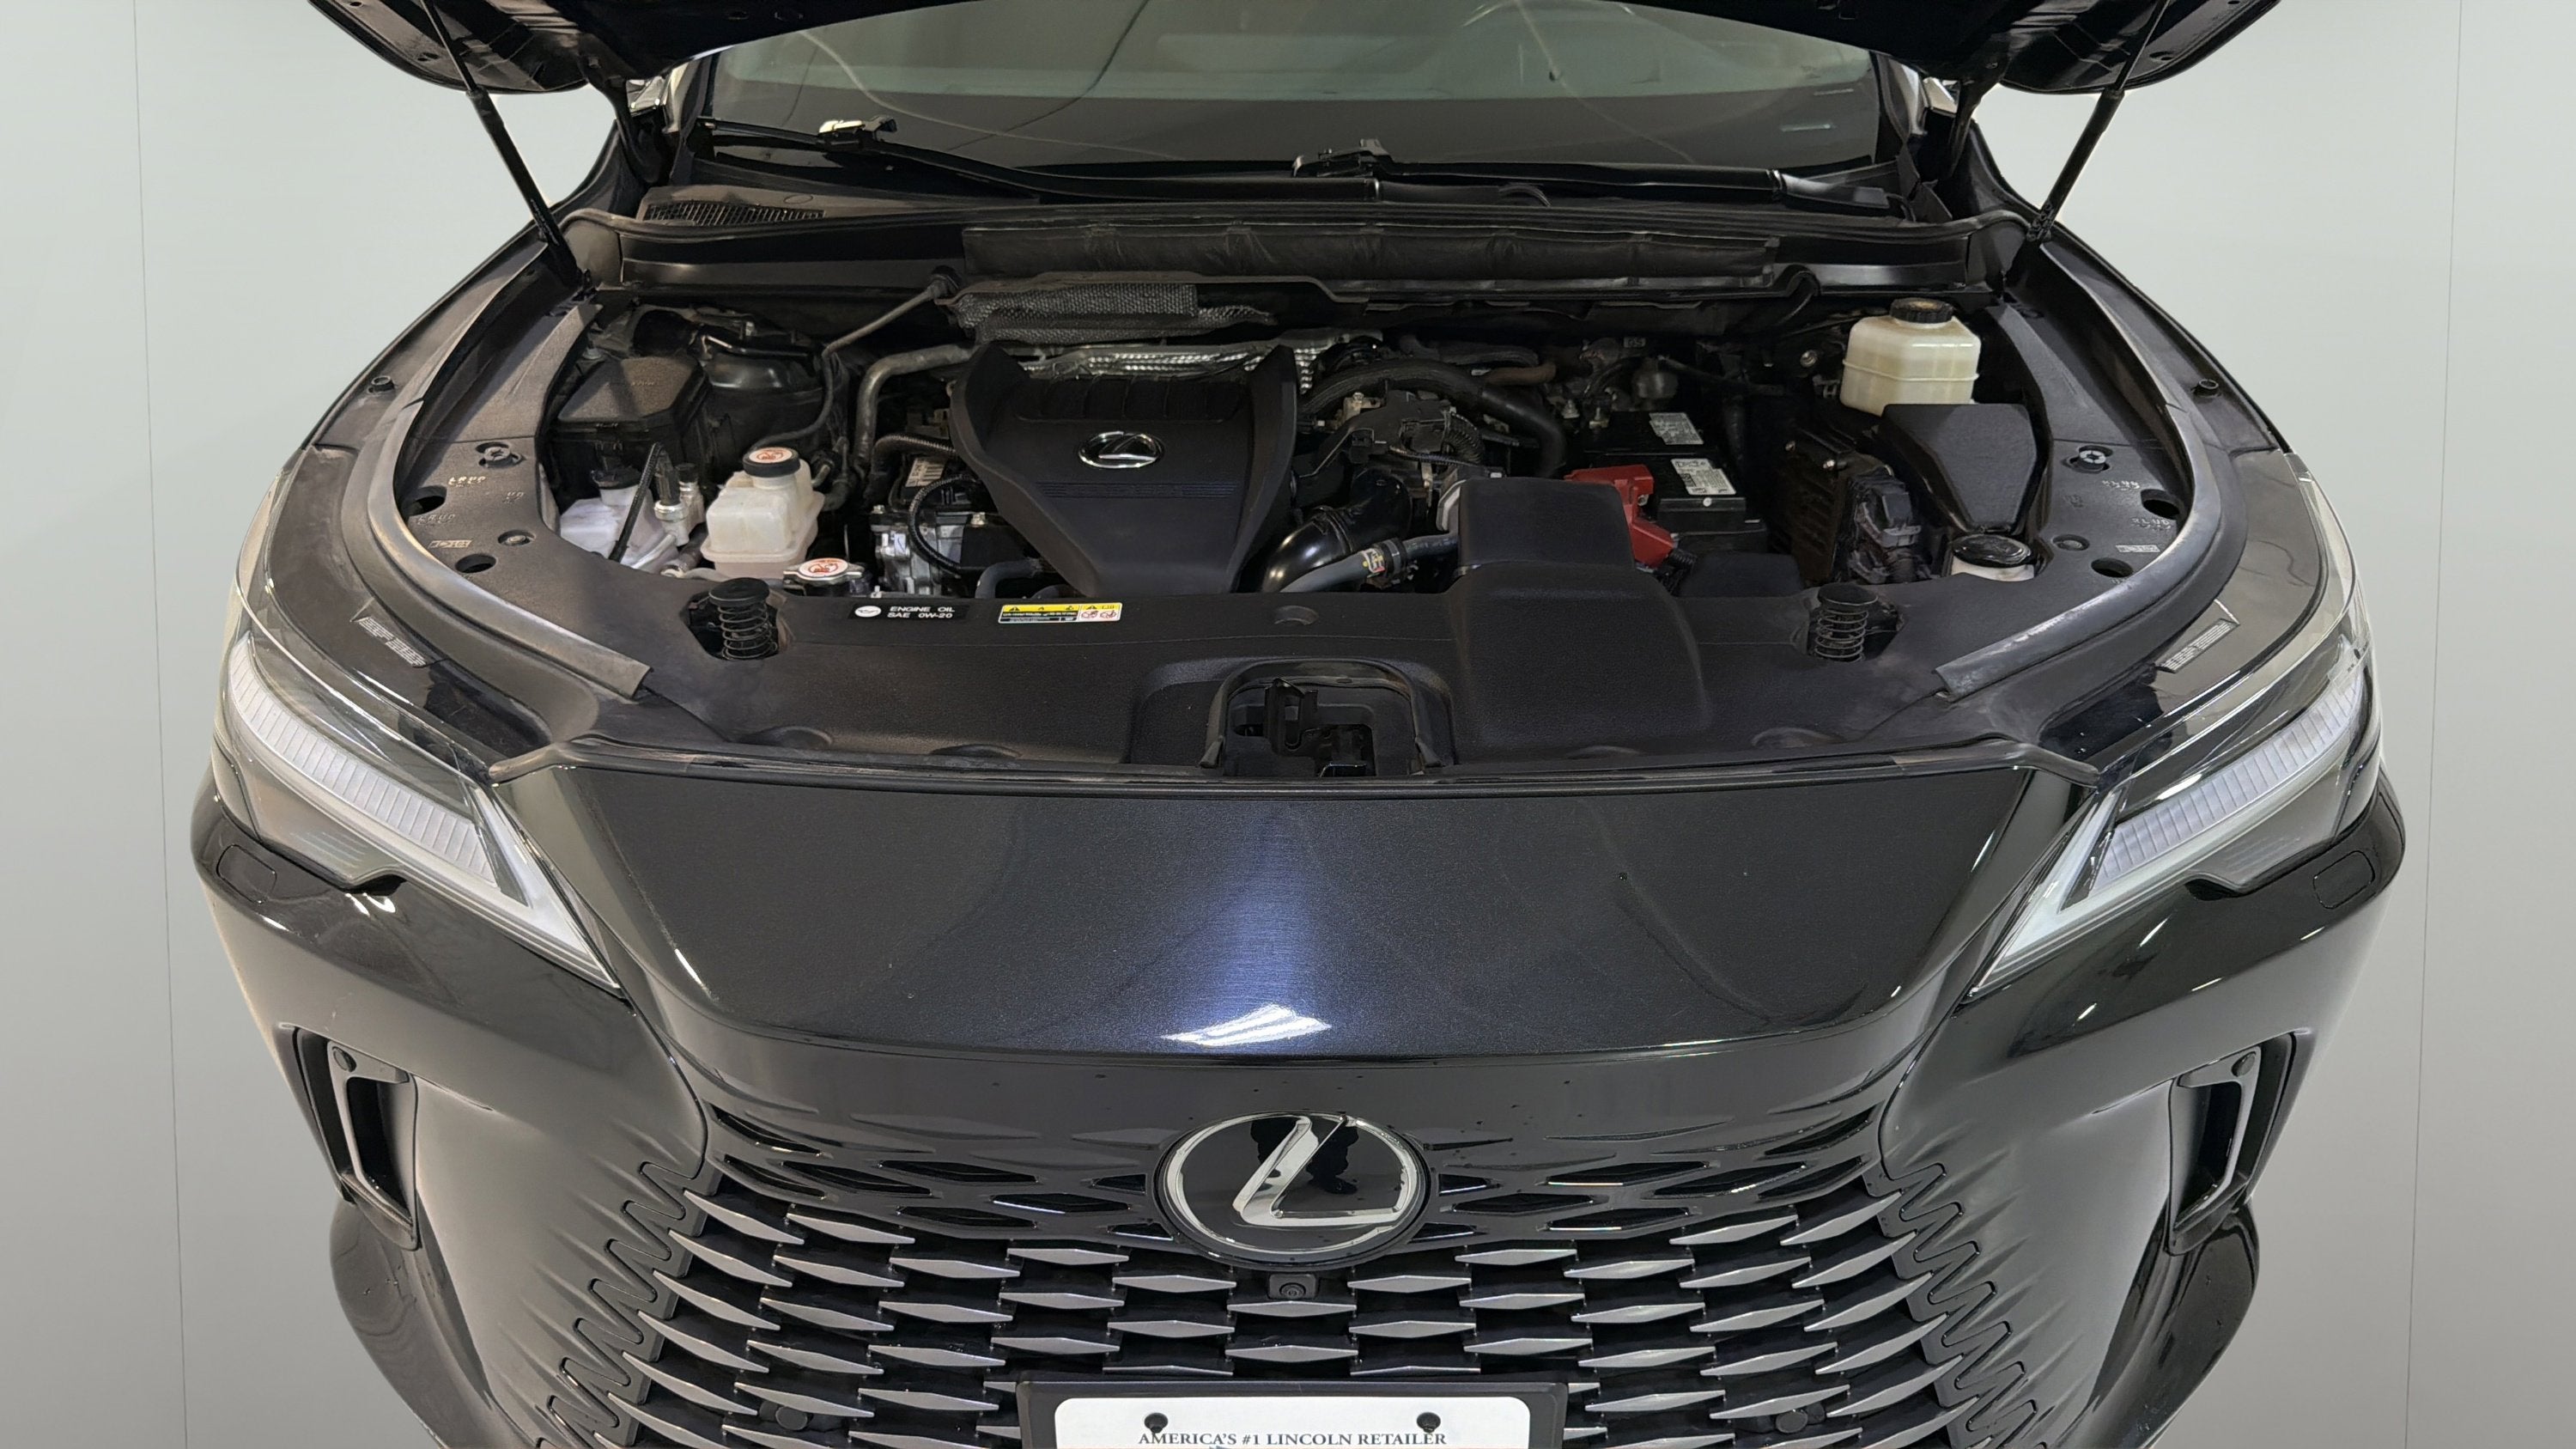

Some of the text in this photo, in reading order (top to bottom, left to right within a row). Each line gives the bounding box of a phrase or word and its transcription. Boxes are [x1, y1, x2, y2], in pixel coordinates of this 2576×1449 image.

[1242, 1434, 1261, 1445] #1
[1267, 1433, 1352, 1445] LINCOLN
[1358, 1433, 1447, 1445] RETAILER
